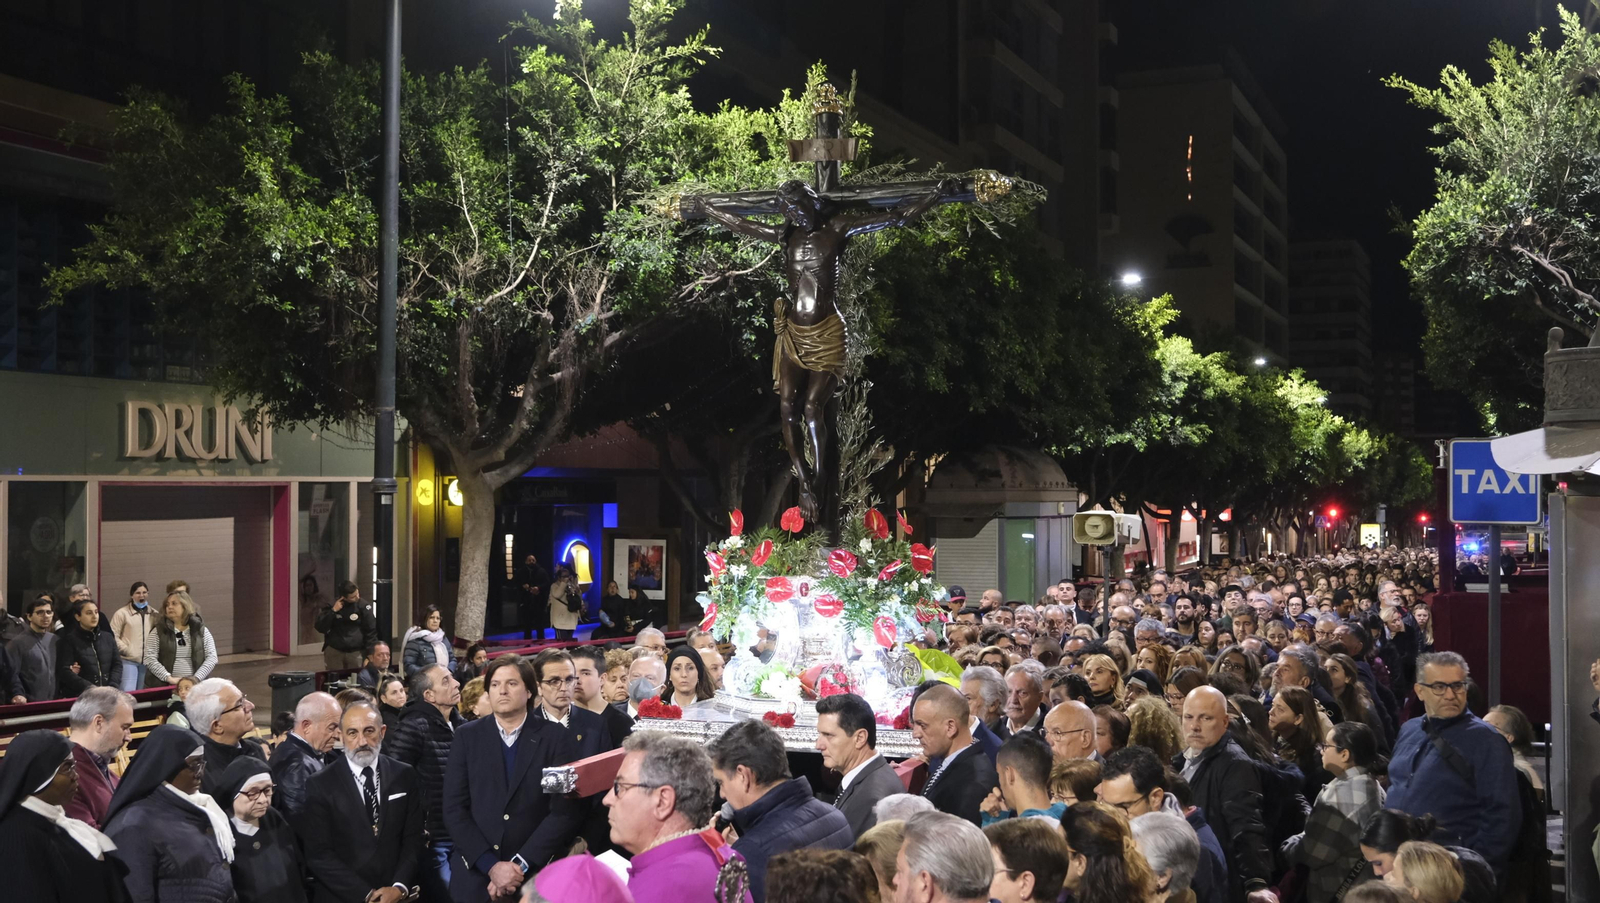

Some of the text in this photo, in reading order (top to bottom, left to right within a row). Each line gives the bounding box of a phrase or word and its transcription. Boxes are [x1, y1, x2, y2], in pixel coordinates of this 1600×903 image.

[126, 401, 273, 462] DRUNI
[1455, 469, 1536, 494] TAXI
[1354, 856, 1367, 873] LOL
